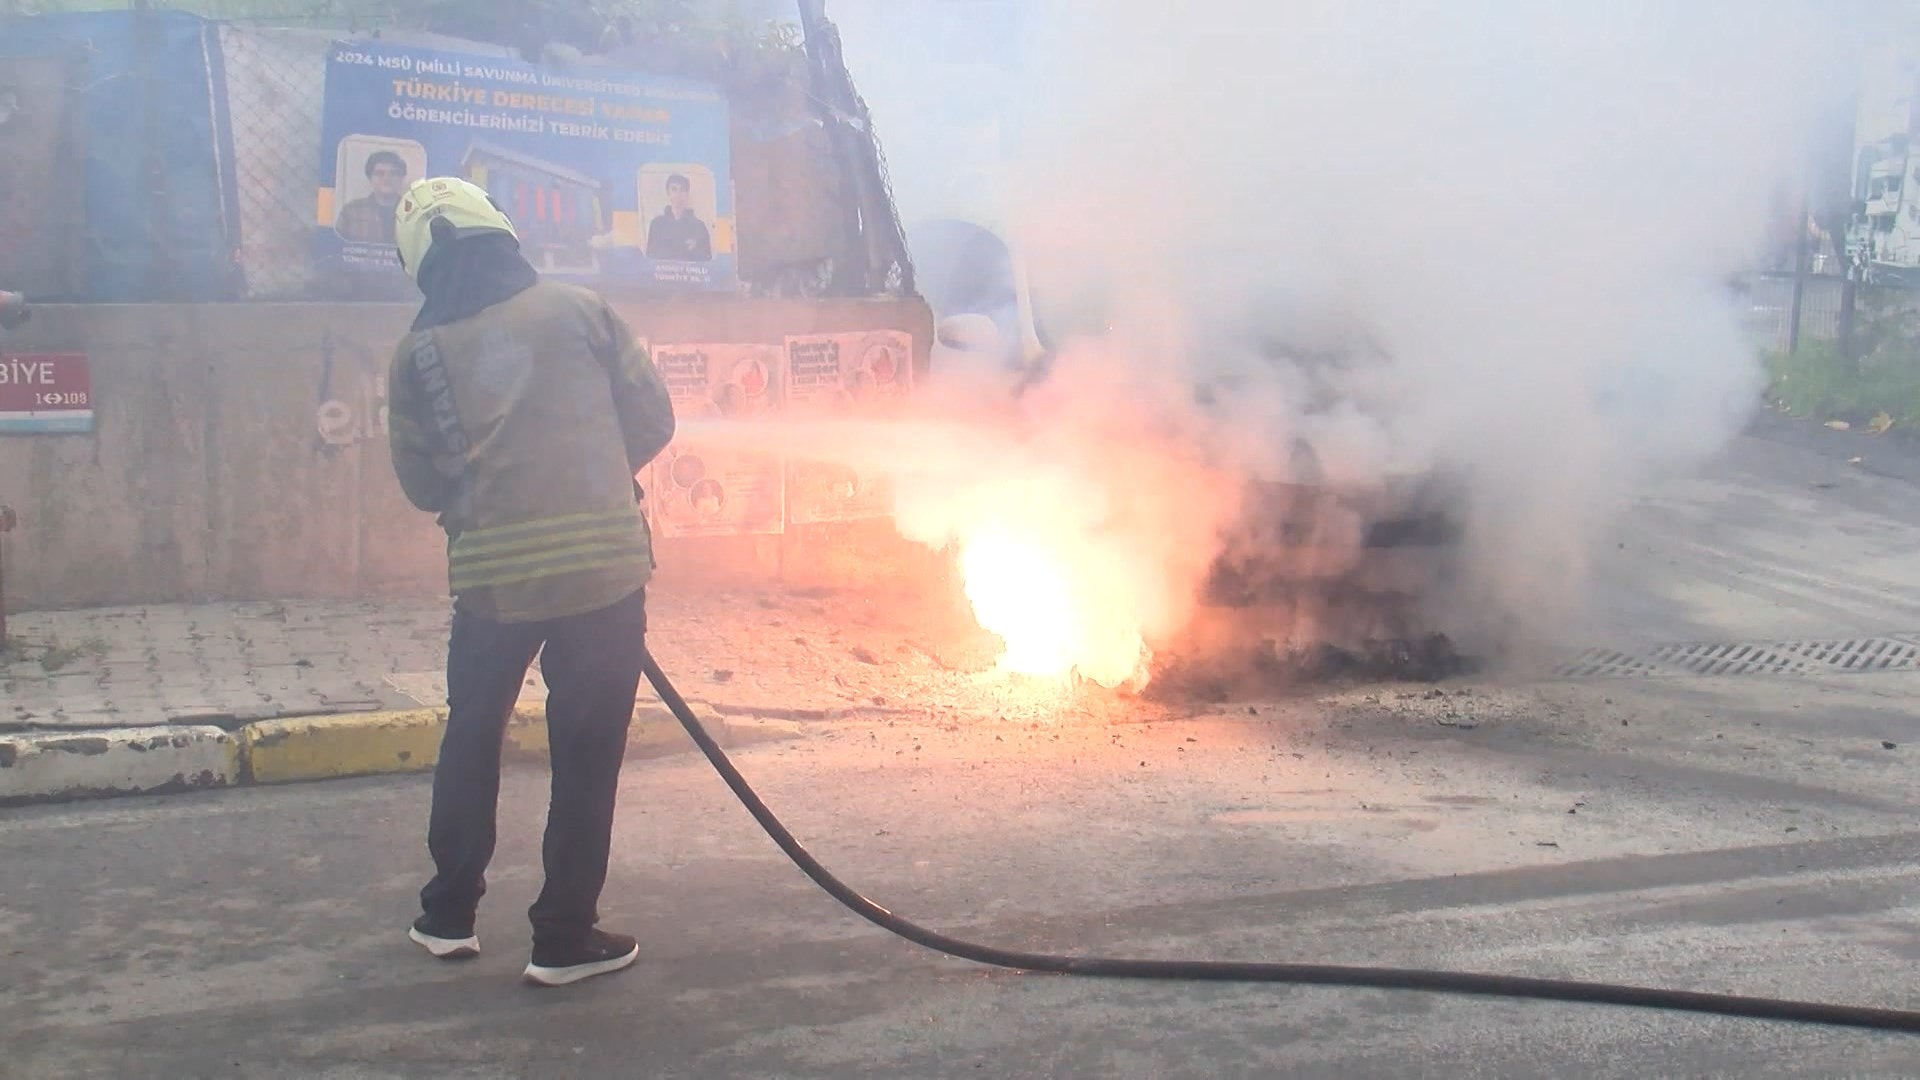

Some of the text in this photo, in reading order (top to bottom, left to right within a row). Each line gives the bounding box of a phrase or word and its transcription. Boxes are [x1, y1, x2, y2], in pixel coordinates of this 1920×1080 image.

[335, 51, 374, 67] 2024
[377, 54, 412, 72] MSÜ
[415, 58, 461, 77] (MİLLİ
[464, 66, 538, 85] SAVUNMA
[392, 76, 488, 106] TÜRKİYE
[387, 100, 545, 134] ÖĞRENCİLERİMİZİ
[549, 120, 610, 141] TEBRİK
